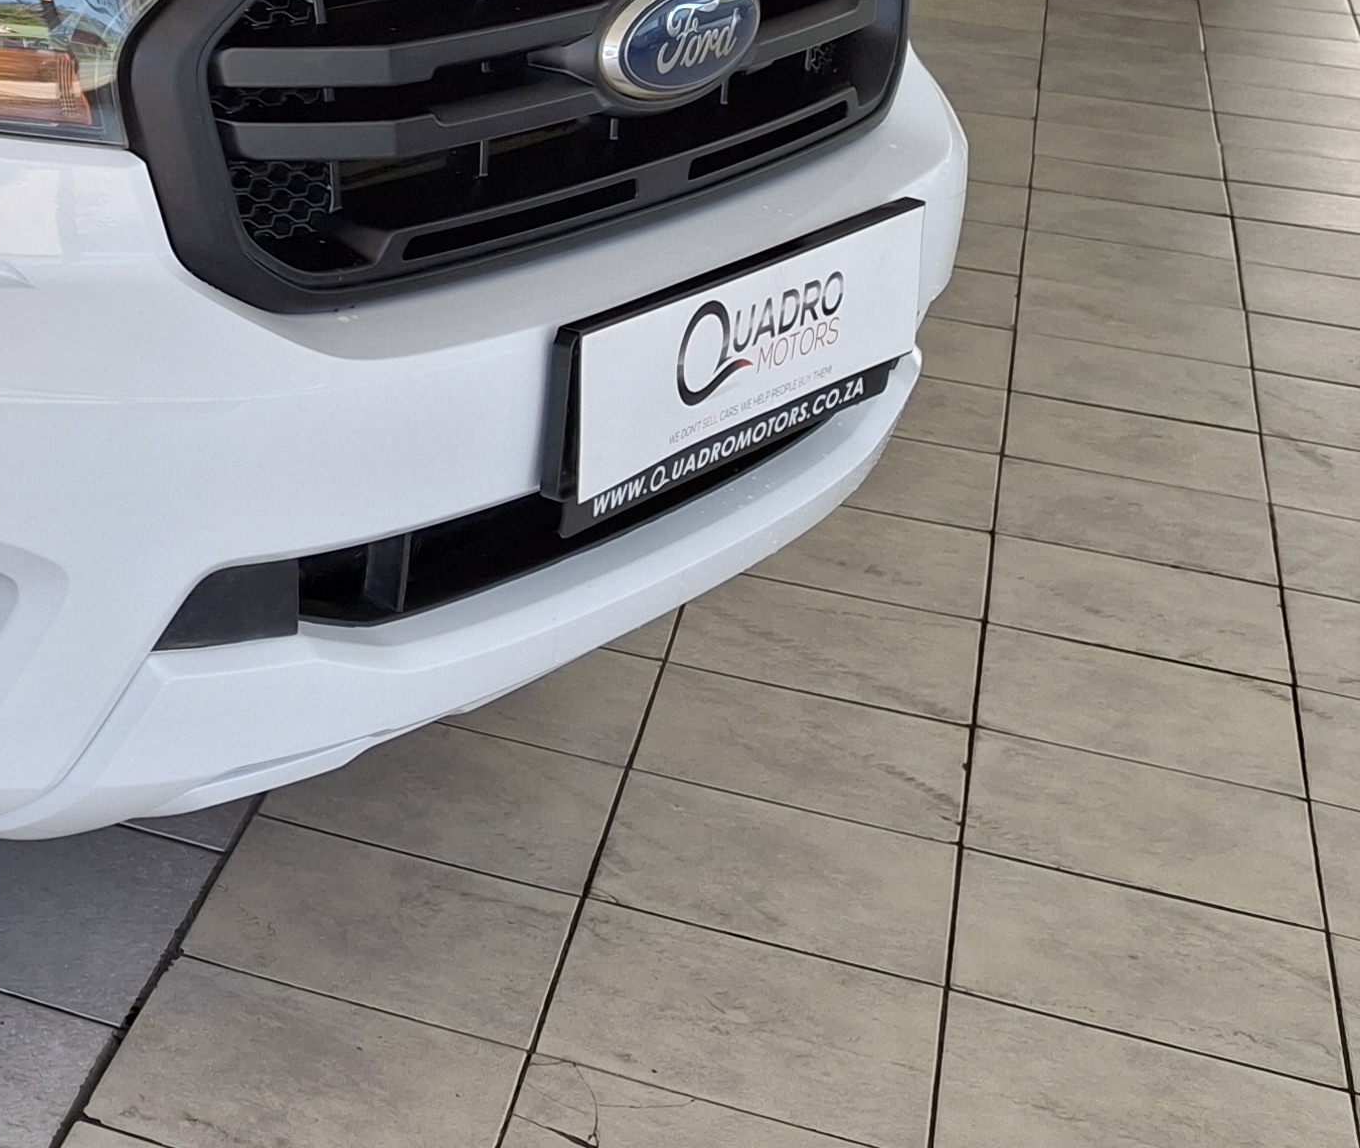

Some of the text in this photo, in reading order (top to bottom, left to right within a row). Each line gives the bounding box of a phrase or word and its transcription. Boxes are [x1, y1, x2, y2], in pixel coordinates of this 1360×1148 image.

[677, 270, 844, 407] QUADRO
[756, 316, 841, 375] MOTORS
[591, 376, 865, 519] WWW.QUADROMOTORS.CO.ZA
[668, 431, 681, 445] WE
[701, 414, 718, 428] SELL
[740, 399, 753, 412] WE
[753, 393, 771, 407] HELP
[770, 381, 798, 400] PEOPLE
[798, 374, 813, 388] BUY
